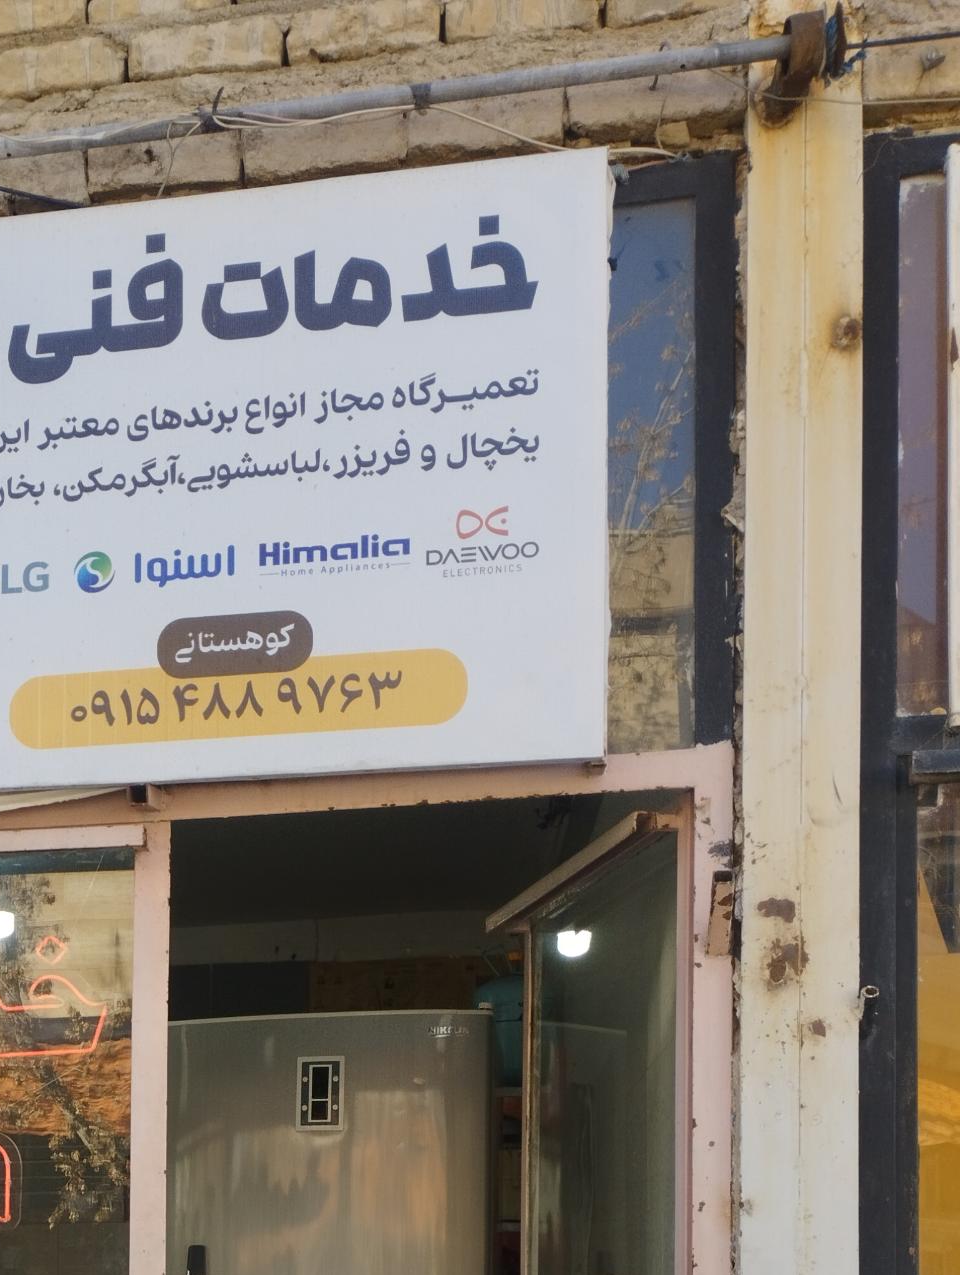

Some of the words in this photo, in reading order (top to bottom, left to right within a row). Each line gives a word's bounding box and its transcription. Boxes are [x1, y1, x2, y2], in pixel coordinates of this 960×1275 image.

[201, 215, 539, 342] خدمات
[8, 233, 184, 385] فنی
[313, 390, 384, 424] مجاز
[392, 368, 539, 413] تعمیرگاه
[126, 402, 238, 441] برندهای
[245, 391, 306, 434] انواع
[37, 416, 119, 449] معتبر
[446, 427, 540, 471] یخچال
[420, 443, 437, 471] و
[134, 544, 235, 586] اسنوا
[259, 534, 411, 567] Himalia
[280, 566, 315, 577] Home
[321, 562, 391, 577] Appliances
[426, 540, 539, 567] DAEWOO
[1, 561, 50, 595] LG
[443, 563, 523, 578] ELECTRONICS
[175, 624, 295, 663] کوهستانی
[70, 690, 160, 727] ۰۹۱۵
[174, 681, 264, 721] ۴۸۸
[277, 670, 403, 716] ۹۷۶۳
